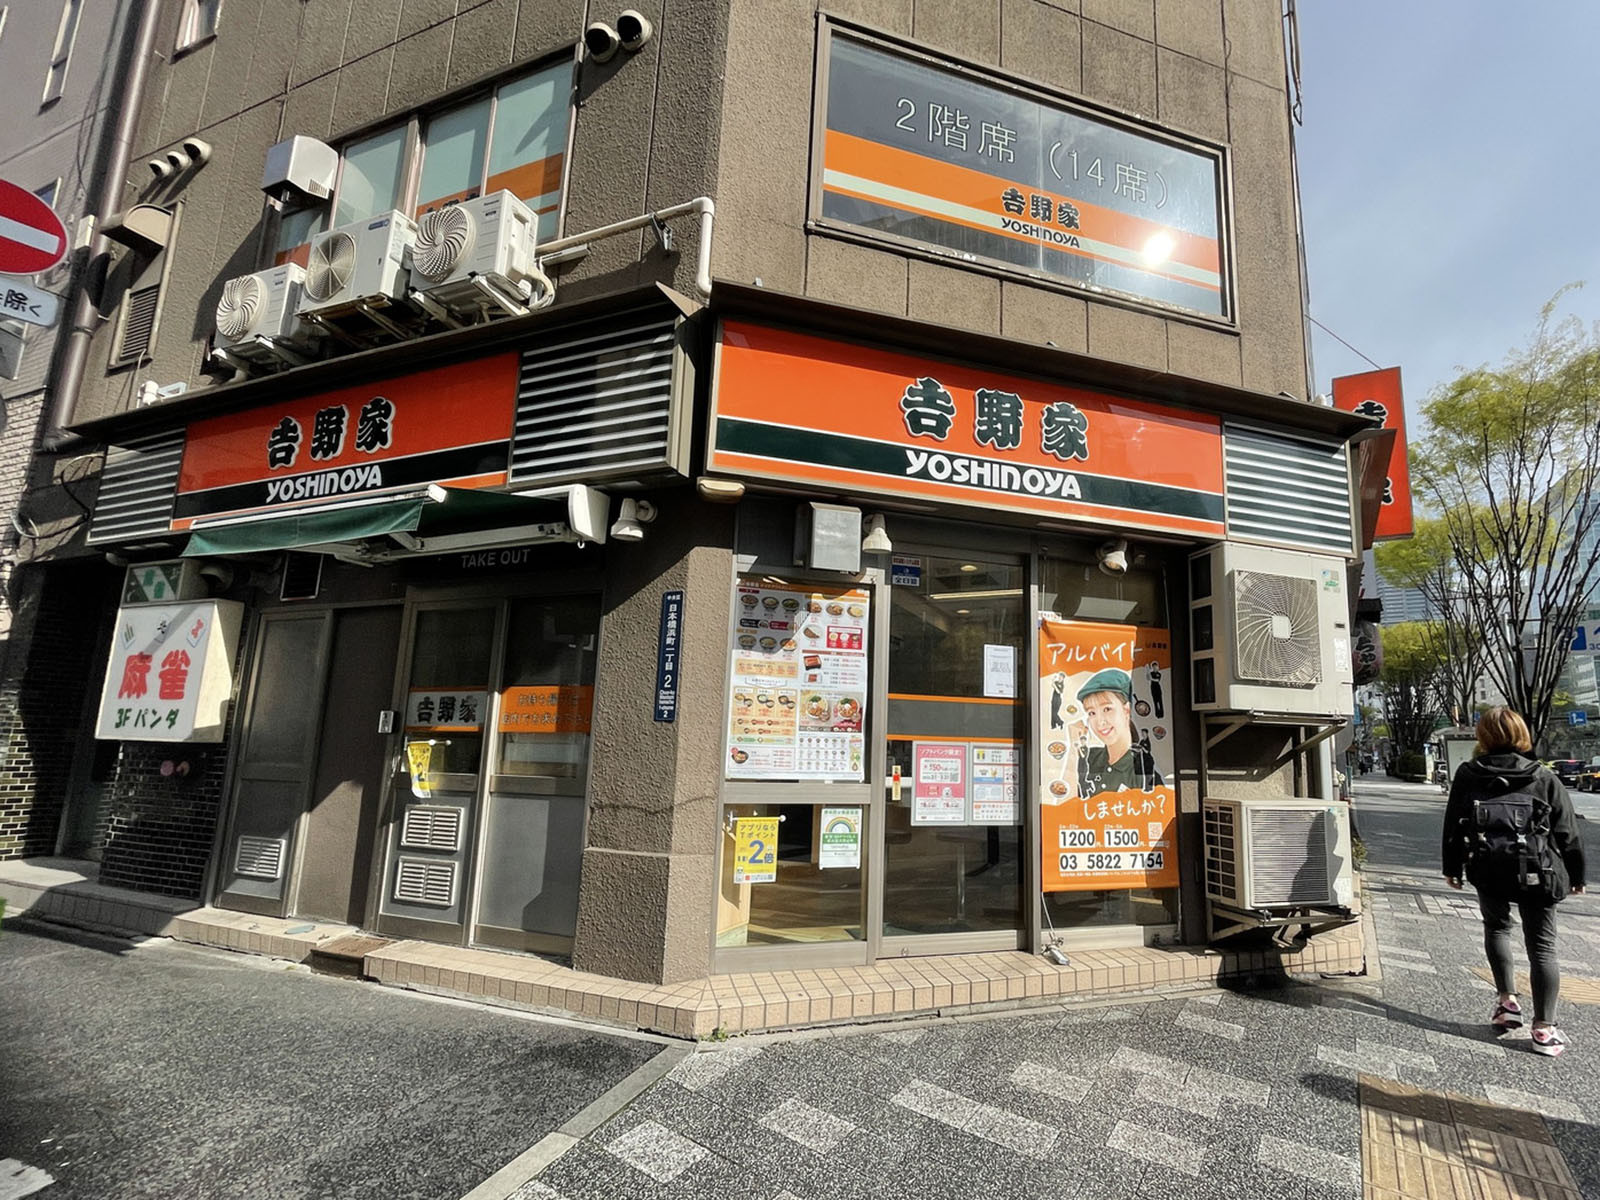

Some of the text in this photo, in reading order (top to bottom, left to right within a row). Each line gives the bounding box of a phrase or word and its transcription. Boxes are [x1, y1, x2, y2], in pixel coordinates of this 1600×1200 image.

[894, 98, 1018, 164] 2階席
[1001, 187, 1081, 231] 吉野家
[1001, 217, 1081, 249] YOSHINOYA
[0, 289, 42, 317] 除く
[267, 396, 395, 470] 吉野家
[901, 376, 1088, 461] 吉野家
[265, 464, 383, 504] YOSHINOYA
[905, 449, 1082, 499] YOSHINOYA
[461, 548, 531, 568] TAKE OUT
[1046, 640, 1143, 665] アルバイト
[118, 649, 191, 700] 麻雀
[663, 674, 672, 688] 2
[417, 696, 478, 723] 吉野家
[1083, 794, 1166, 821] しませんか?
[1061, 831, 1139, 847] 1200 1500
[1060, 853, 1163, 870] 03 5822 7154
